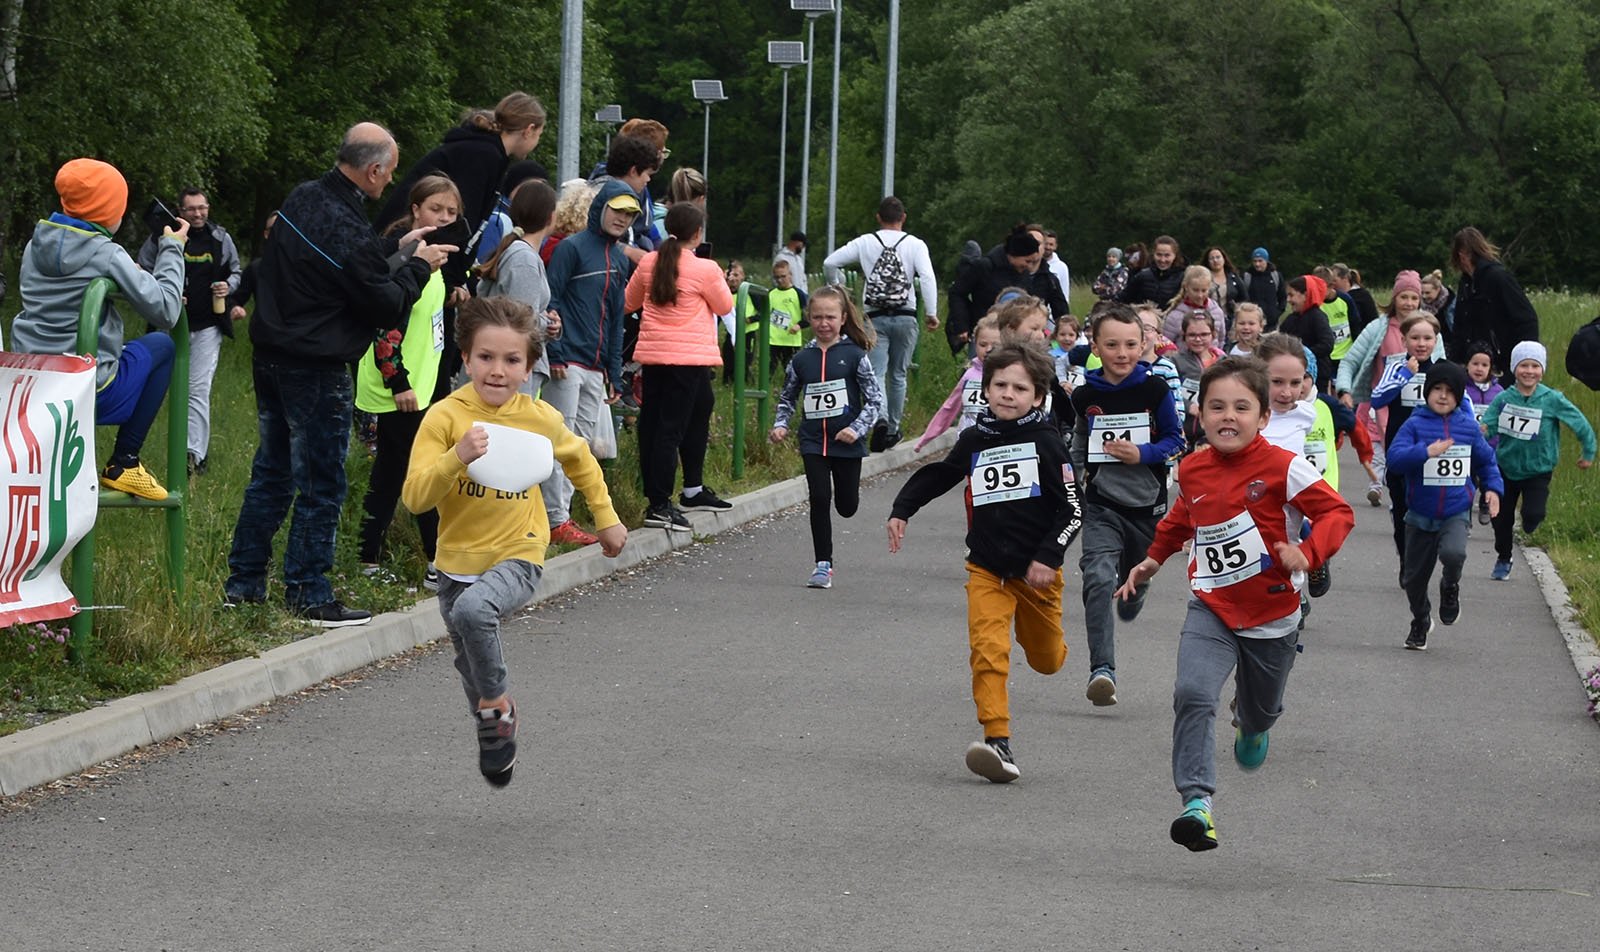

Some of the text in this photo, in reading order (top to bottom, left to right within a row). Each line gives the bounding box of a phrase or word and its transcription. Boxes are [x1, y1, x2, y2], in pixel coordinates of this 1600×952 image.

[811, 393, 837, 411] 79
[1507, 415, 1530, 433] 17
[983, 463, 1022, 491] 95
[1436, 459, 1463, 477] 89
[457, 479, 486, 498] YOU
[1204, 539, 1247, 574] 85
